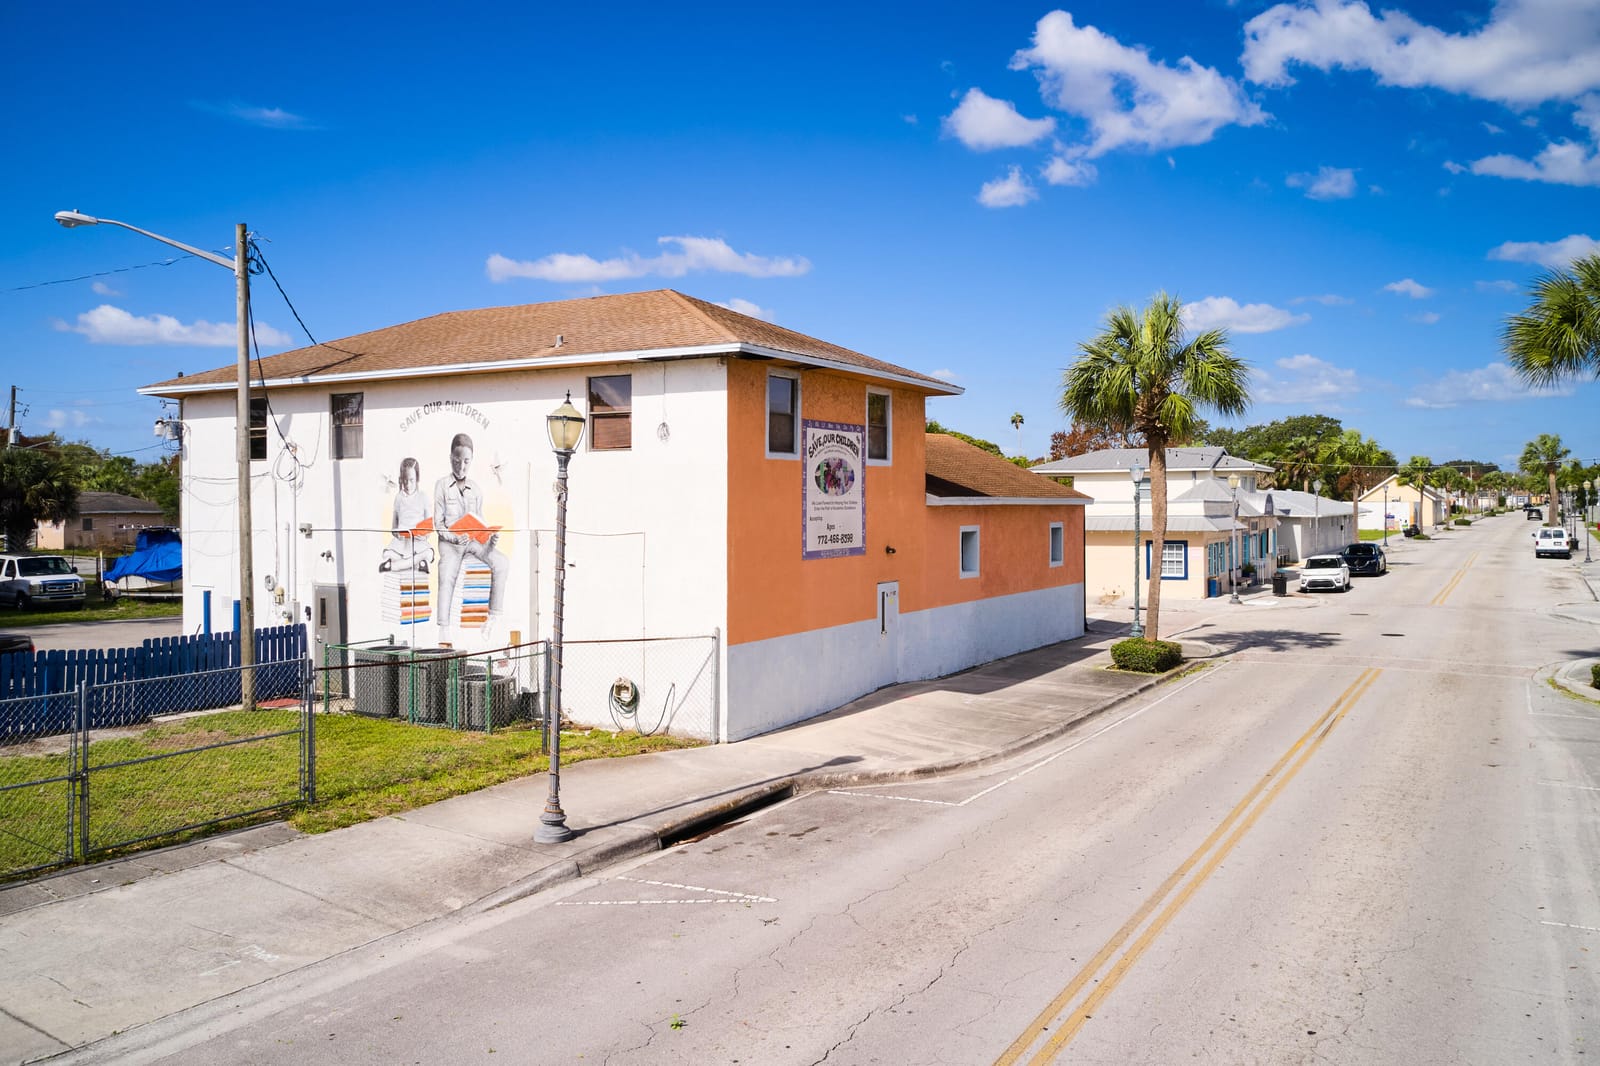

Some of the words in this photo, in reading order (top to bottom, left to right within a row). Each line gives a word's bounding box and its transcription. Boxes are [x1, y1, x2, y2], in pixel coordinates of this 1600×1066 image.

[400, 408, 422, 432] SAVE
[423, 401, 442, 415] OUR
[445, 401, 490, 430] CHILDREN
[823, 433, 836, 447] OUR
[836, 434, 860, 458] CHILDREN
